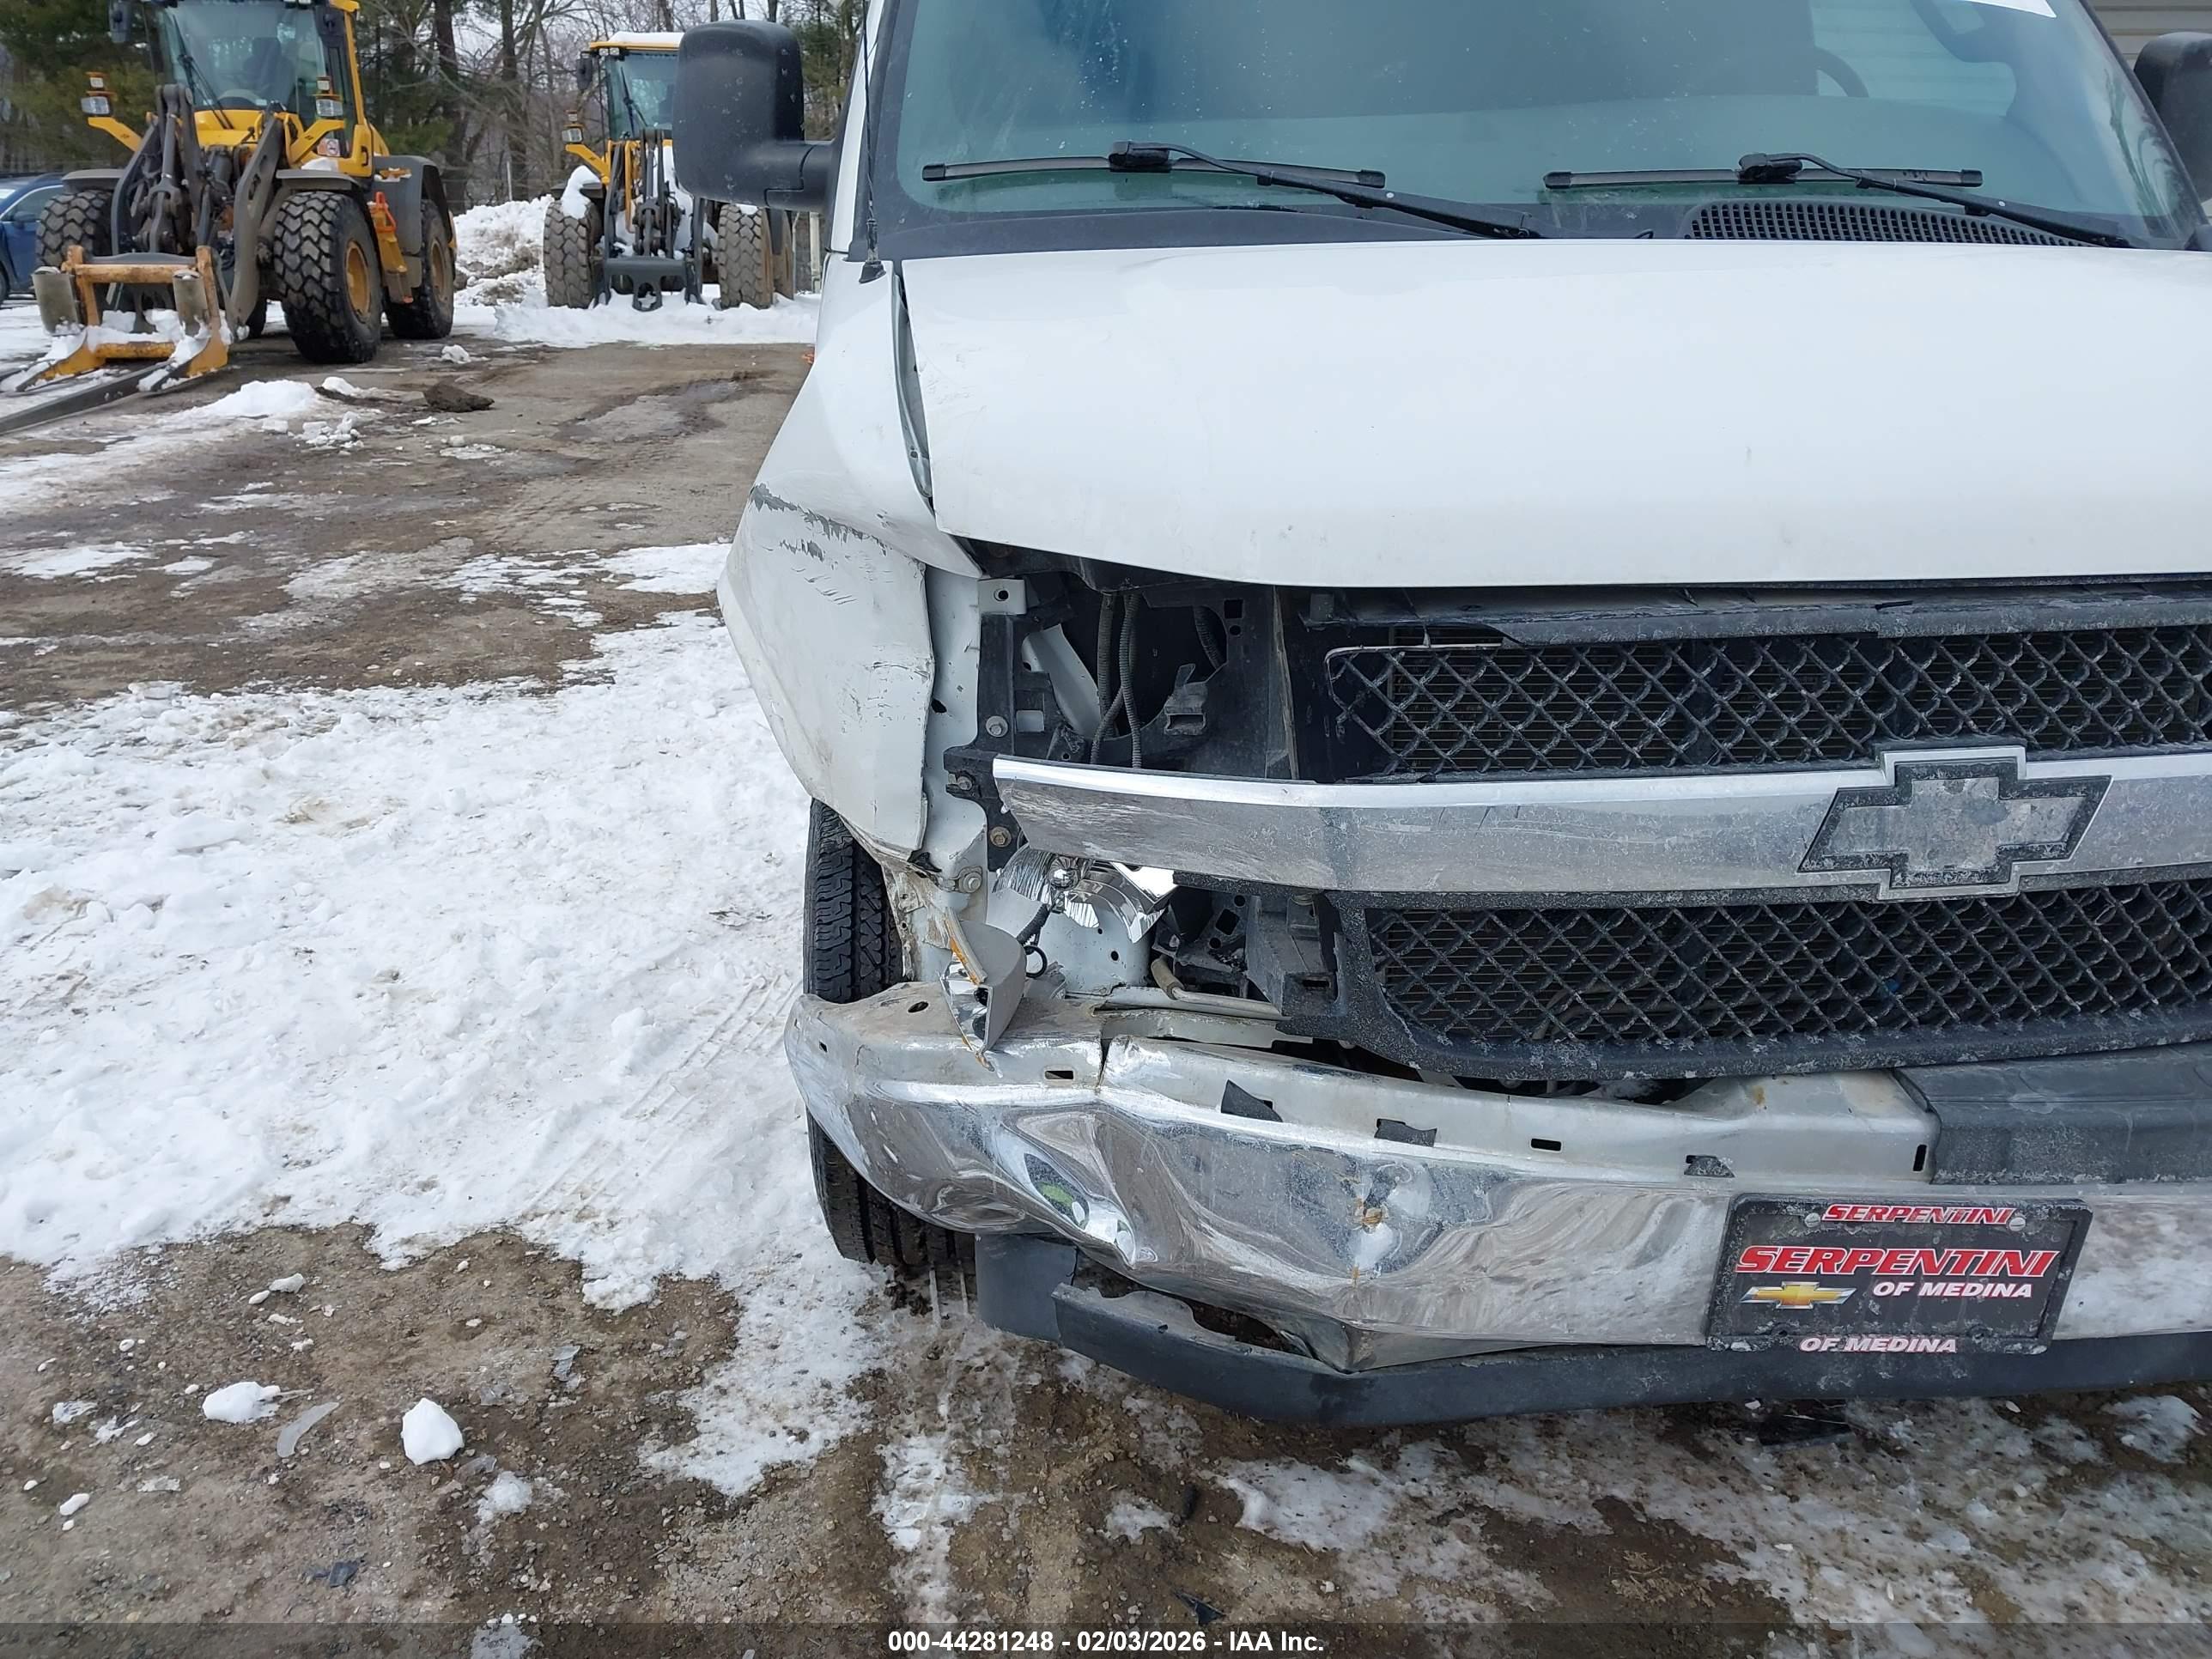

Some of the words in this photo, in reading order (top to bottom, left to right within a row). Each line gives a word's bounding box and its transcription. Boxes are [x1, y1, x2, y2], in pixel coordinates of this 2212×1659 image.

[1821, 1204, 2015, 1224] SERPENTINI
[1735, 1245, 2060, 1278] SERPENTINI
[1873, 1282, 1912, 1297] OF
[1917, 1282, 2033, 1298] MEDINA
[1800, 1338, 1838, 1352] OF
[1844, 1337, 1957, 1353] MEDINA
